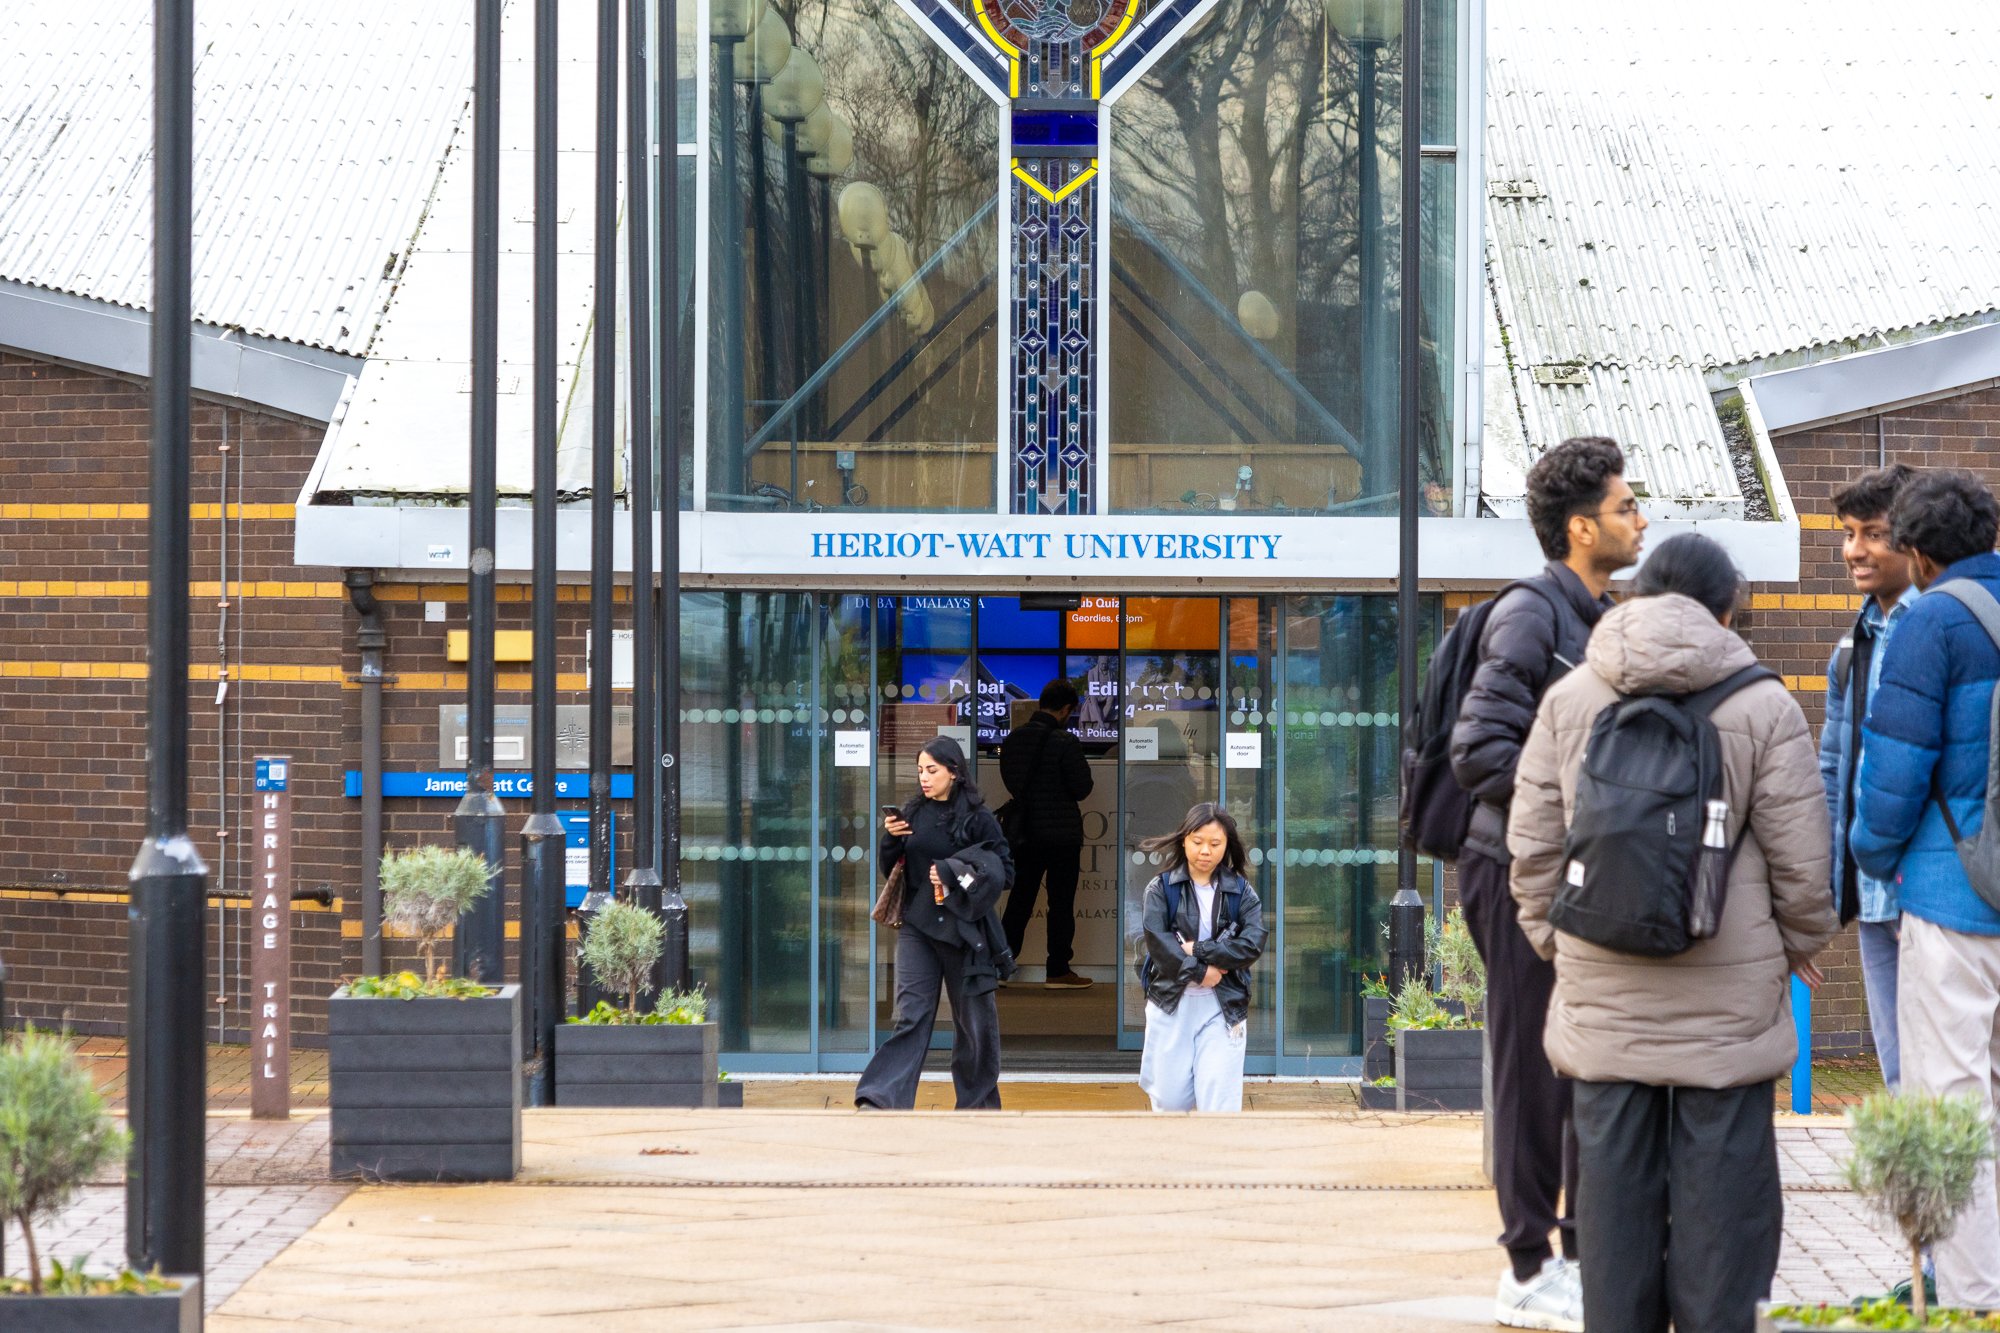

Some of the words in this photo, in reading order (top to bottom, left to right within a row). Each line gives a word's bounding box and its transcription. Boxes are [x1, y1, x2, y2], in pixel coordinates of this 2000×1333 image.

[811, 533, 1051, 559] HERIOT-WATT
[1066, 534, 1283, 560] UNIVERSITY
[915, 597, 985, 609] MALAYSA
[1087, 727, 1119, 738] Police
[256, 778, 267, 787] 01
[493, 779, 514, 792] att
[262, 793, 279, 949] HERITAGE
[262, 982, 278, 1079] TRAIL
